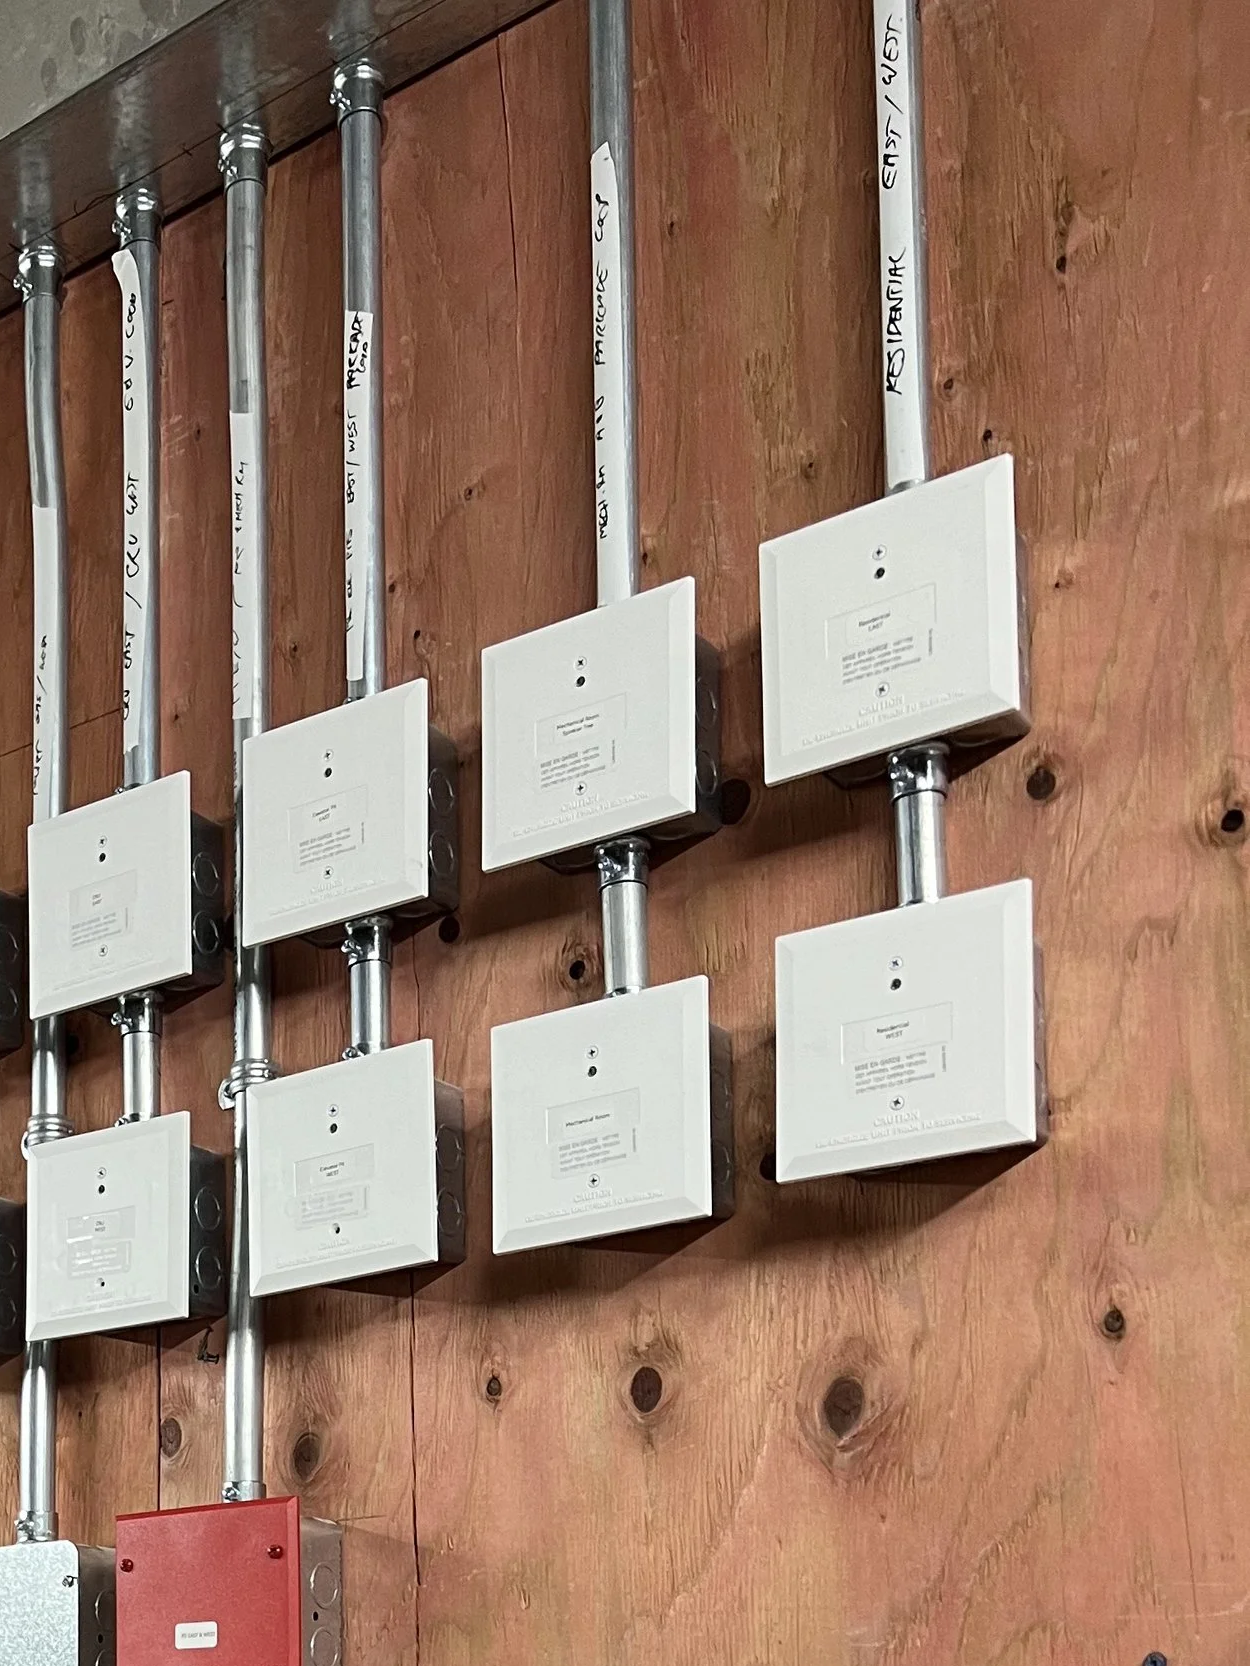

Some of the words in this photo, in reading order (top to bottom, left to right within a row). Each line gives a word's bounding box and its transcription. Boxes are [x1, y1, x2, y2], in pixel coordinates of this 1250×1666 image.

[880, 13, 903, 86] WEST
[881, 114, 903, 190] EAST
[346, 407, 359, 454] WEST
